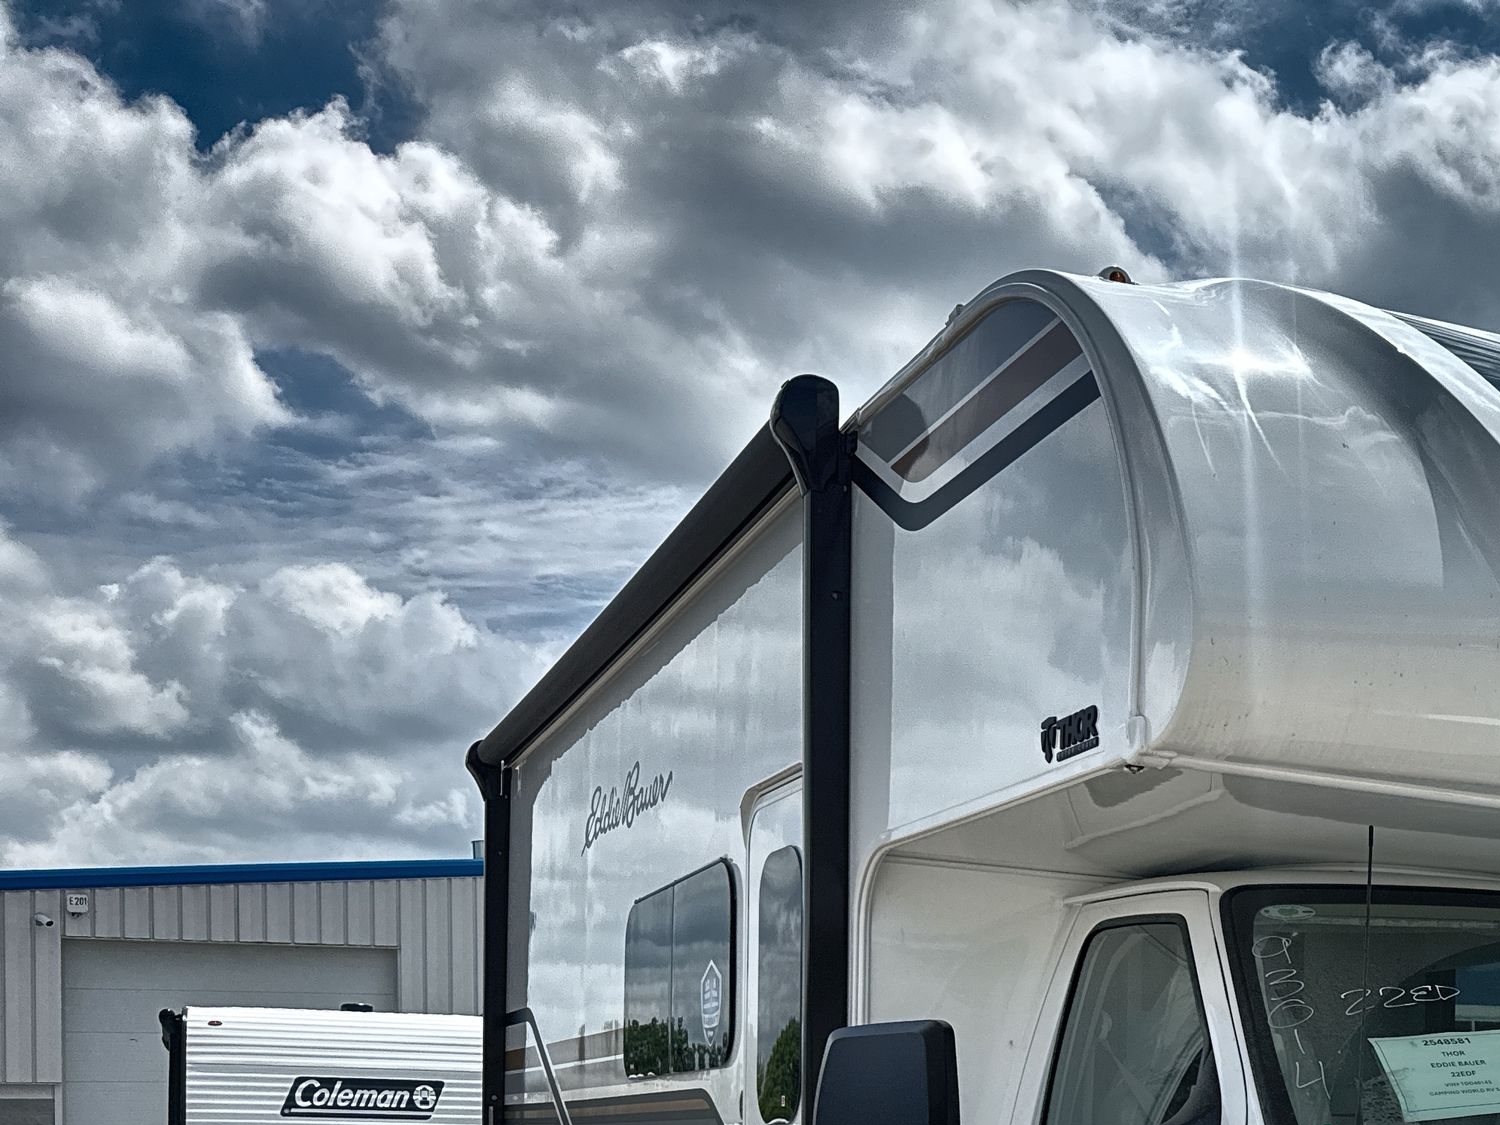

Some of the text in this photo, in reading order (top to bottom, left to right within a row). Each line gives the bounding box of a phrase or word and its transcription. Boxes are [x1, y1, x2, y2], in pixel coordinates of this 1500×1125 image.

[1056, 704, 1098, 750] THOR
[581, 760, 673, 857] Eddie Bauer
[1341, 985, 1460, 1016] 22ED
[1422, 1037, 1471, 1047] 2548581
[1441, 1050, 1466, 1058] THOR
[1430, 1059, 1487, 1069] EDDIE BAUER
[1450, 1070, 1477, 1078] 22EDF
[294, 1079, 410, 1108] Coleman
[1461, 1087, 1486, 1095] WORLD
